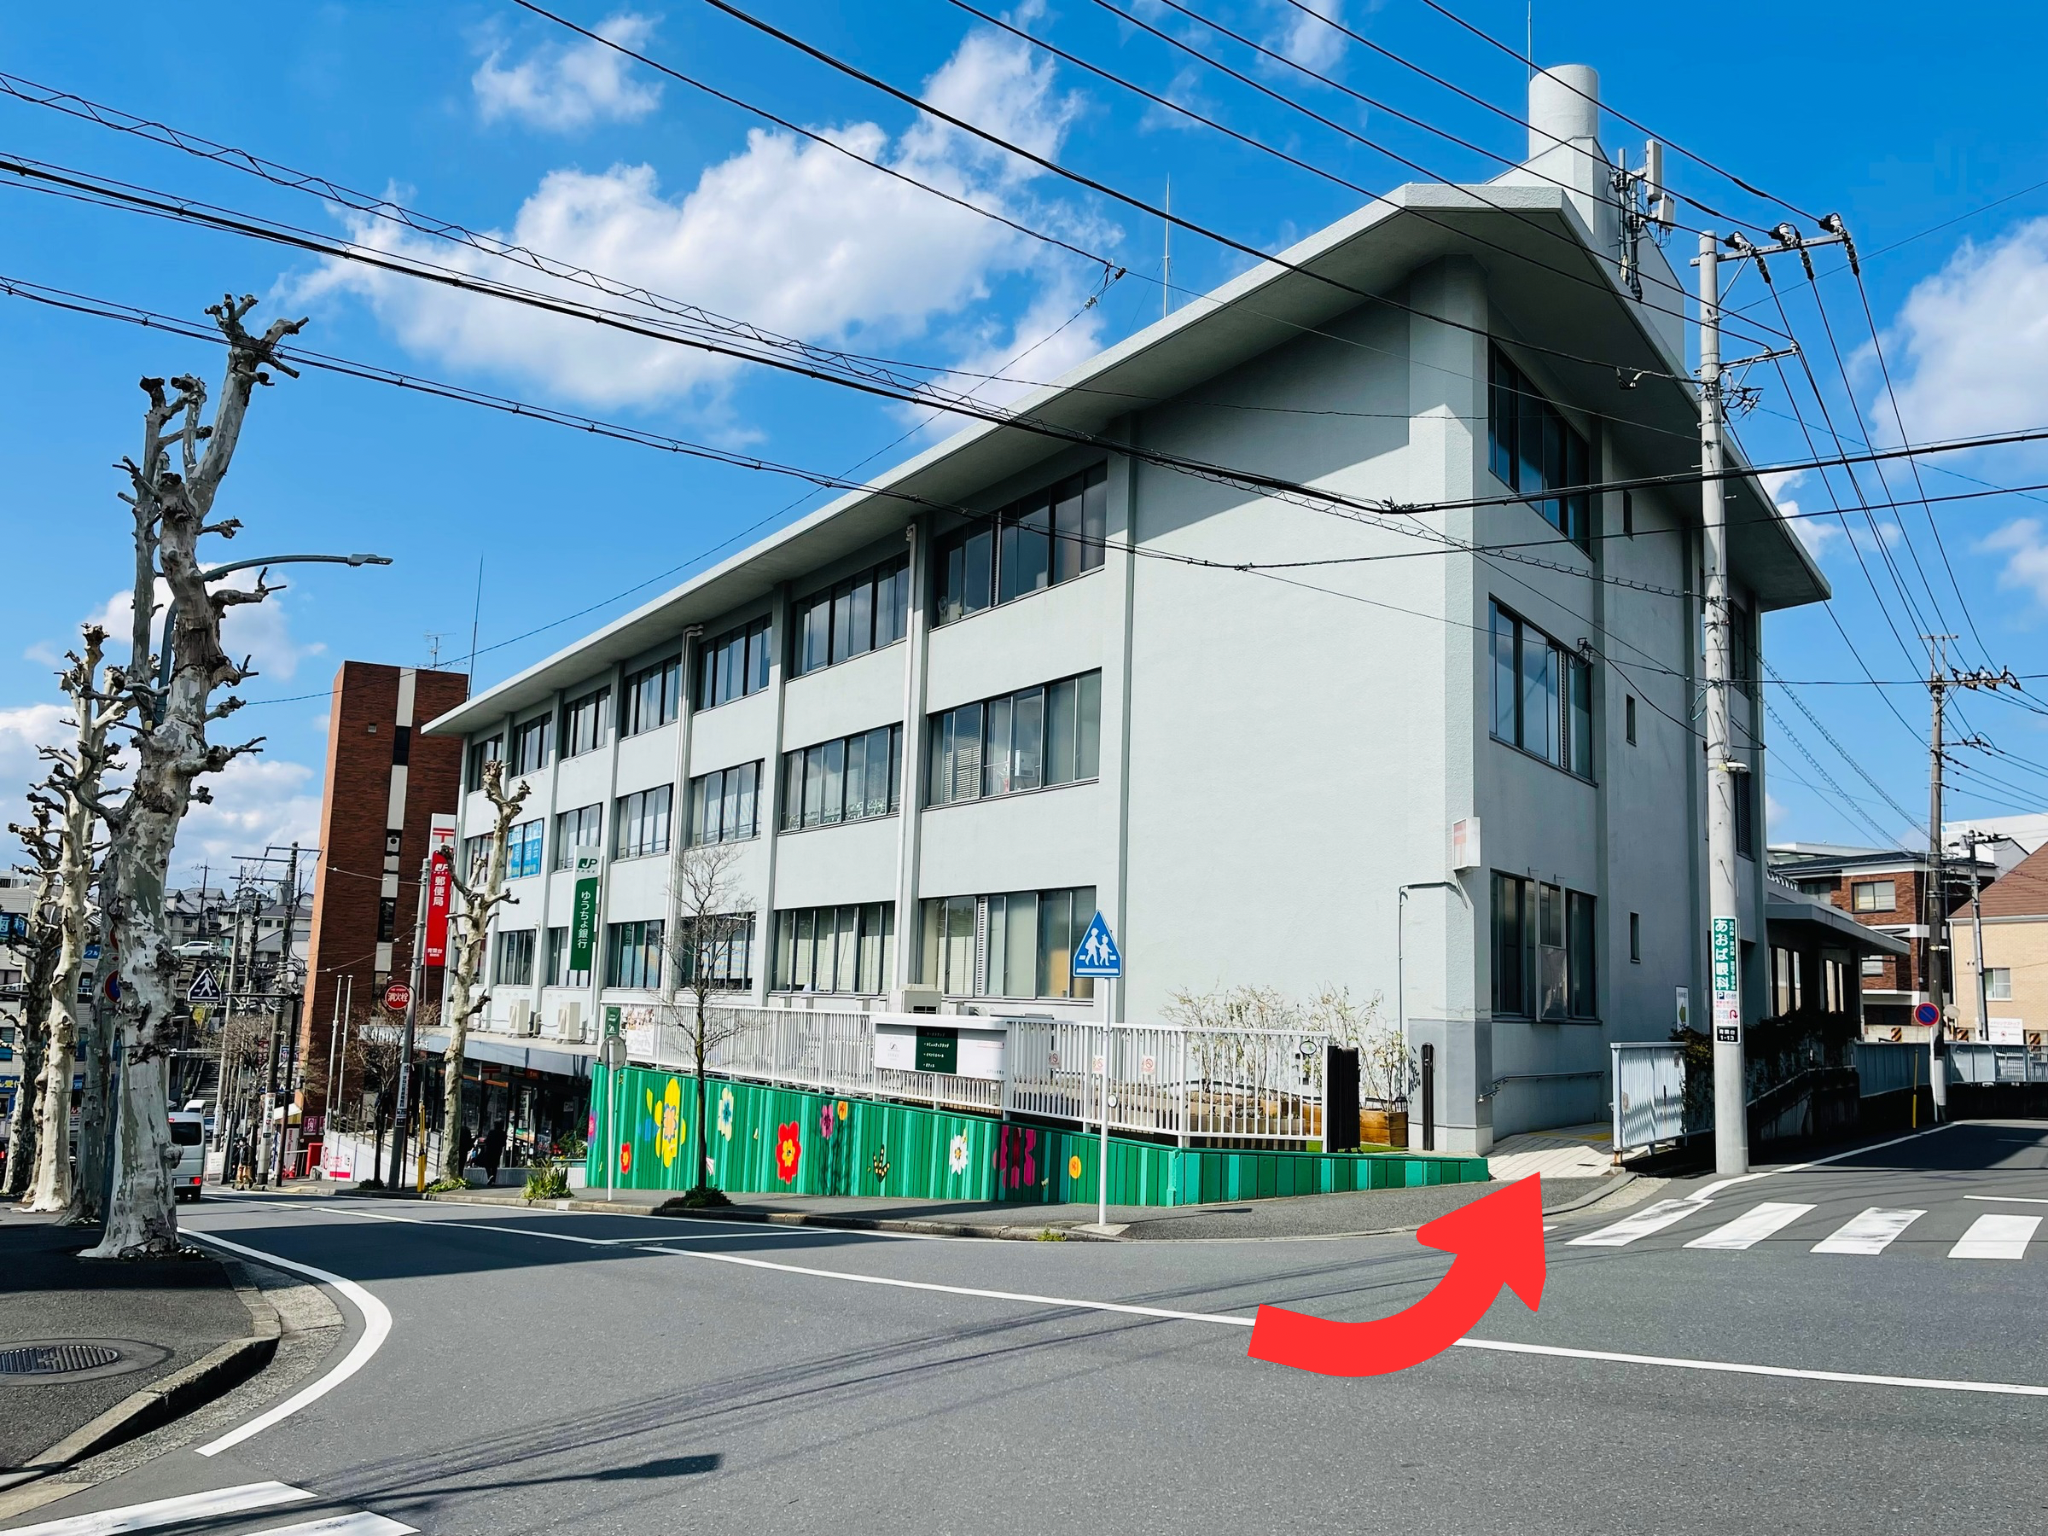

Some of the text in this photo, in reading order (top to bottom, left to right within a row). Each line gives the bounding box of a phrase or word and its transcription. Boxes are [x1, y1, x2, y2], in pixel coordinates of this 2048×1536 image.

[577, 858, 598, 869] JP
[432, 876, 446, 907] 郵便局
[577, 891, 591, 949] ゆうちょ銀行
[1715, 919, 1729, 991] あおば眼科
[388, 992, 409, 1002] 消火栓
